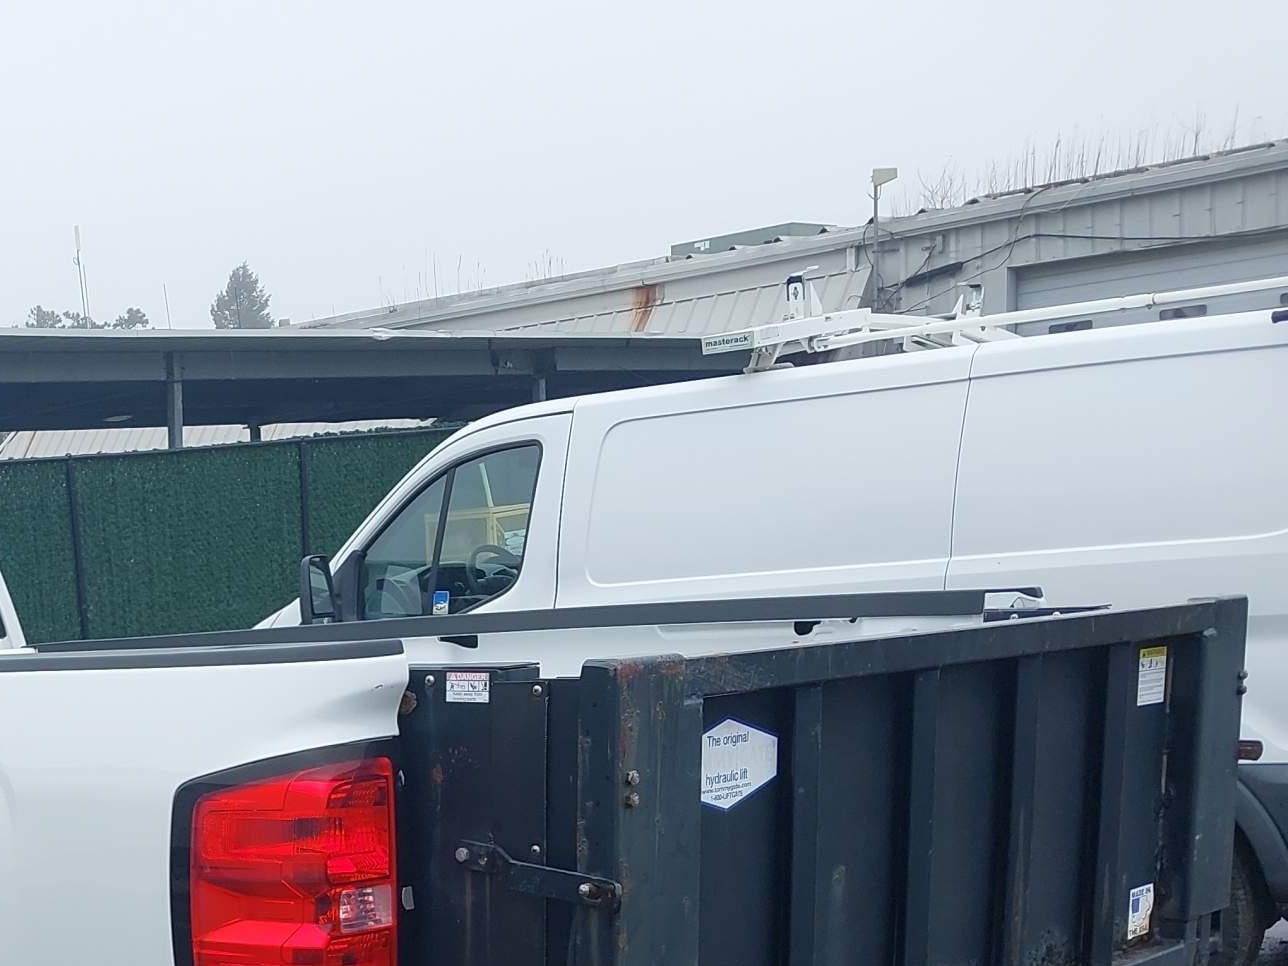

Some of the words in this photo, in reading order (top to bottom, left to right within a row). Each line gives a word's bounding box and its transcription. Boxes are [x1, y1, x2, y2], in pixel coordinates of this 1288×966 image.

[705, 334, 749, 348] masterack
[707, 735, 722, 748] The
[722, 731, 750, 747] original
[705, 769, 739, 789] hydraulic
[739, 768, 748, 780] lift
